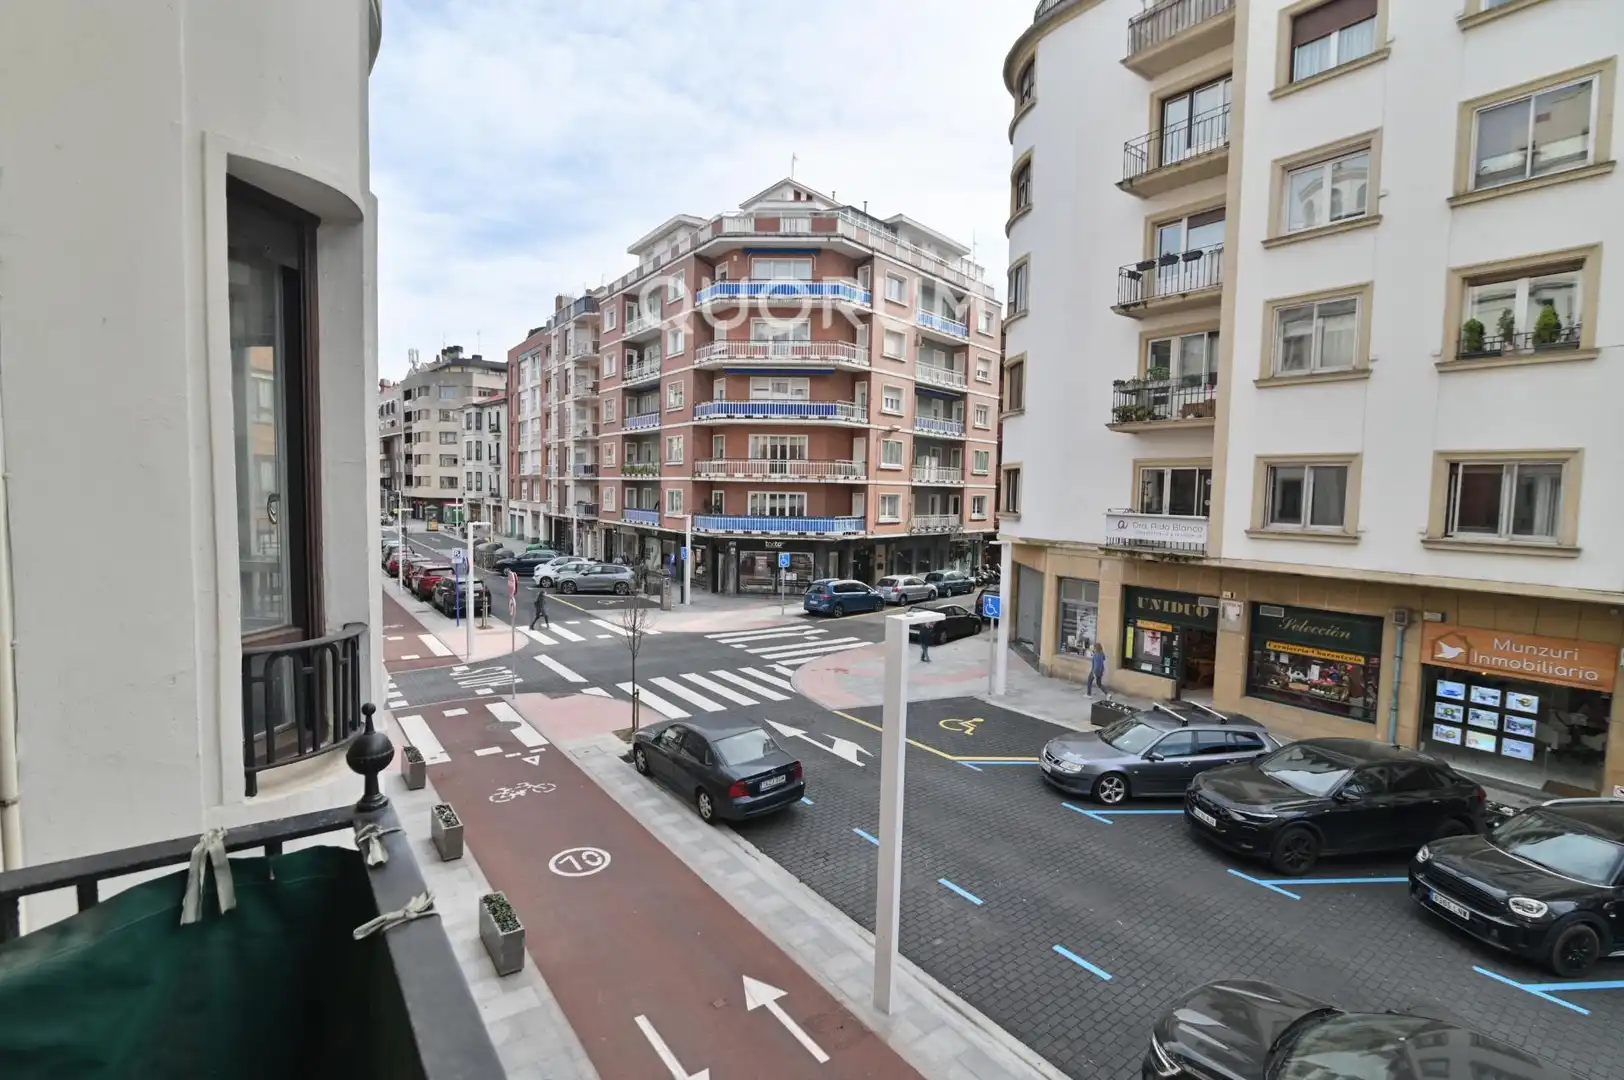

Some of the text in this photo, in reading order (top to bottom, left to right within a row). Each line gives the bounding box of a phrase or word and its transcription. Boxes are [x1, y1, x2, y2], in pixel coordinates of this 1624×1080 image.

[1150, 522, 1170, 531] Ada
[1172, 524, 1204, 533] Blanco
[1137, 596, 1210, 618] UNIDUO
[1278, 616, 1353, 640] Selección
[1493, 638, 1579, 661] Munzuri
[1472, 651, 1599, 681] Inmobiliaria
[558, 851, 603, 871] 10
